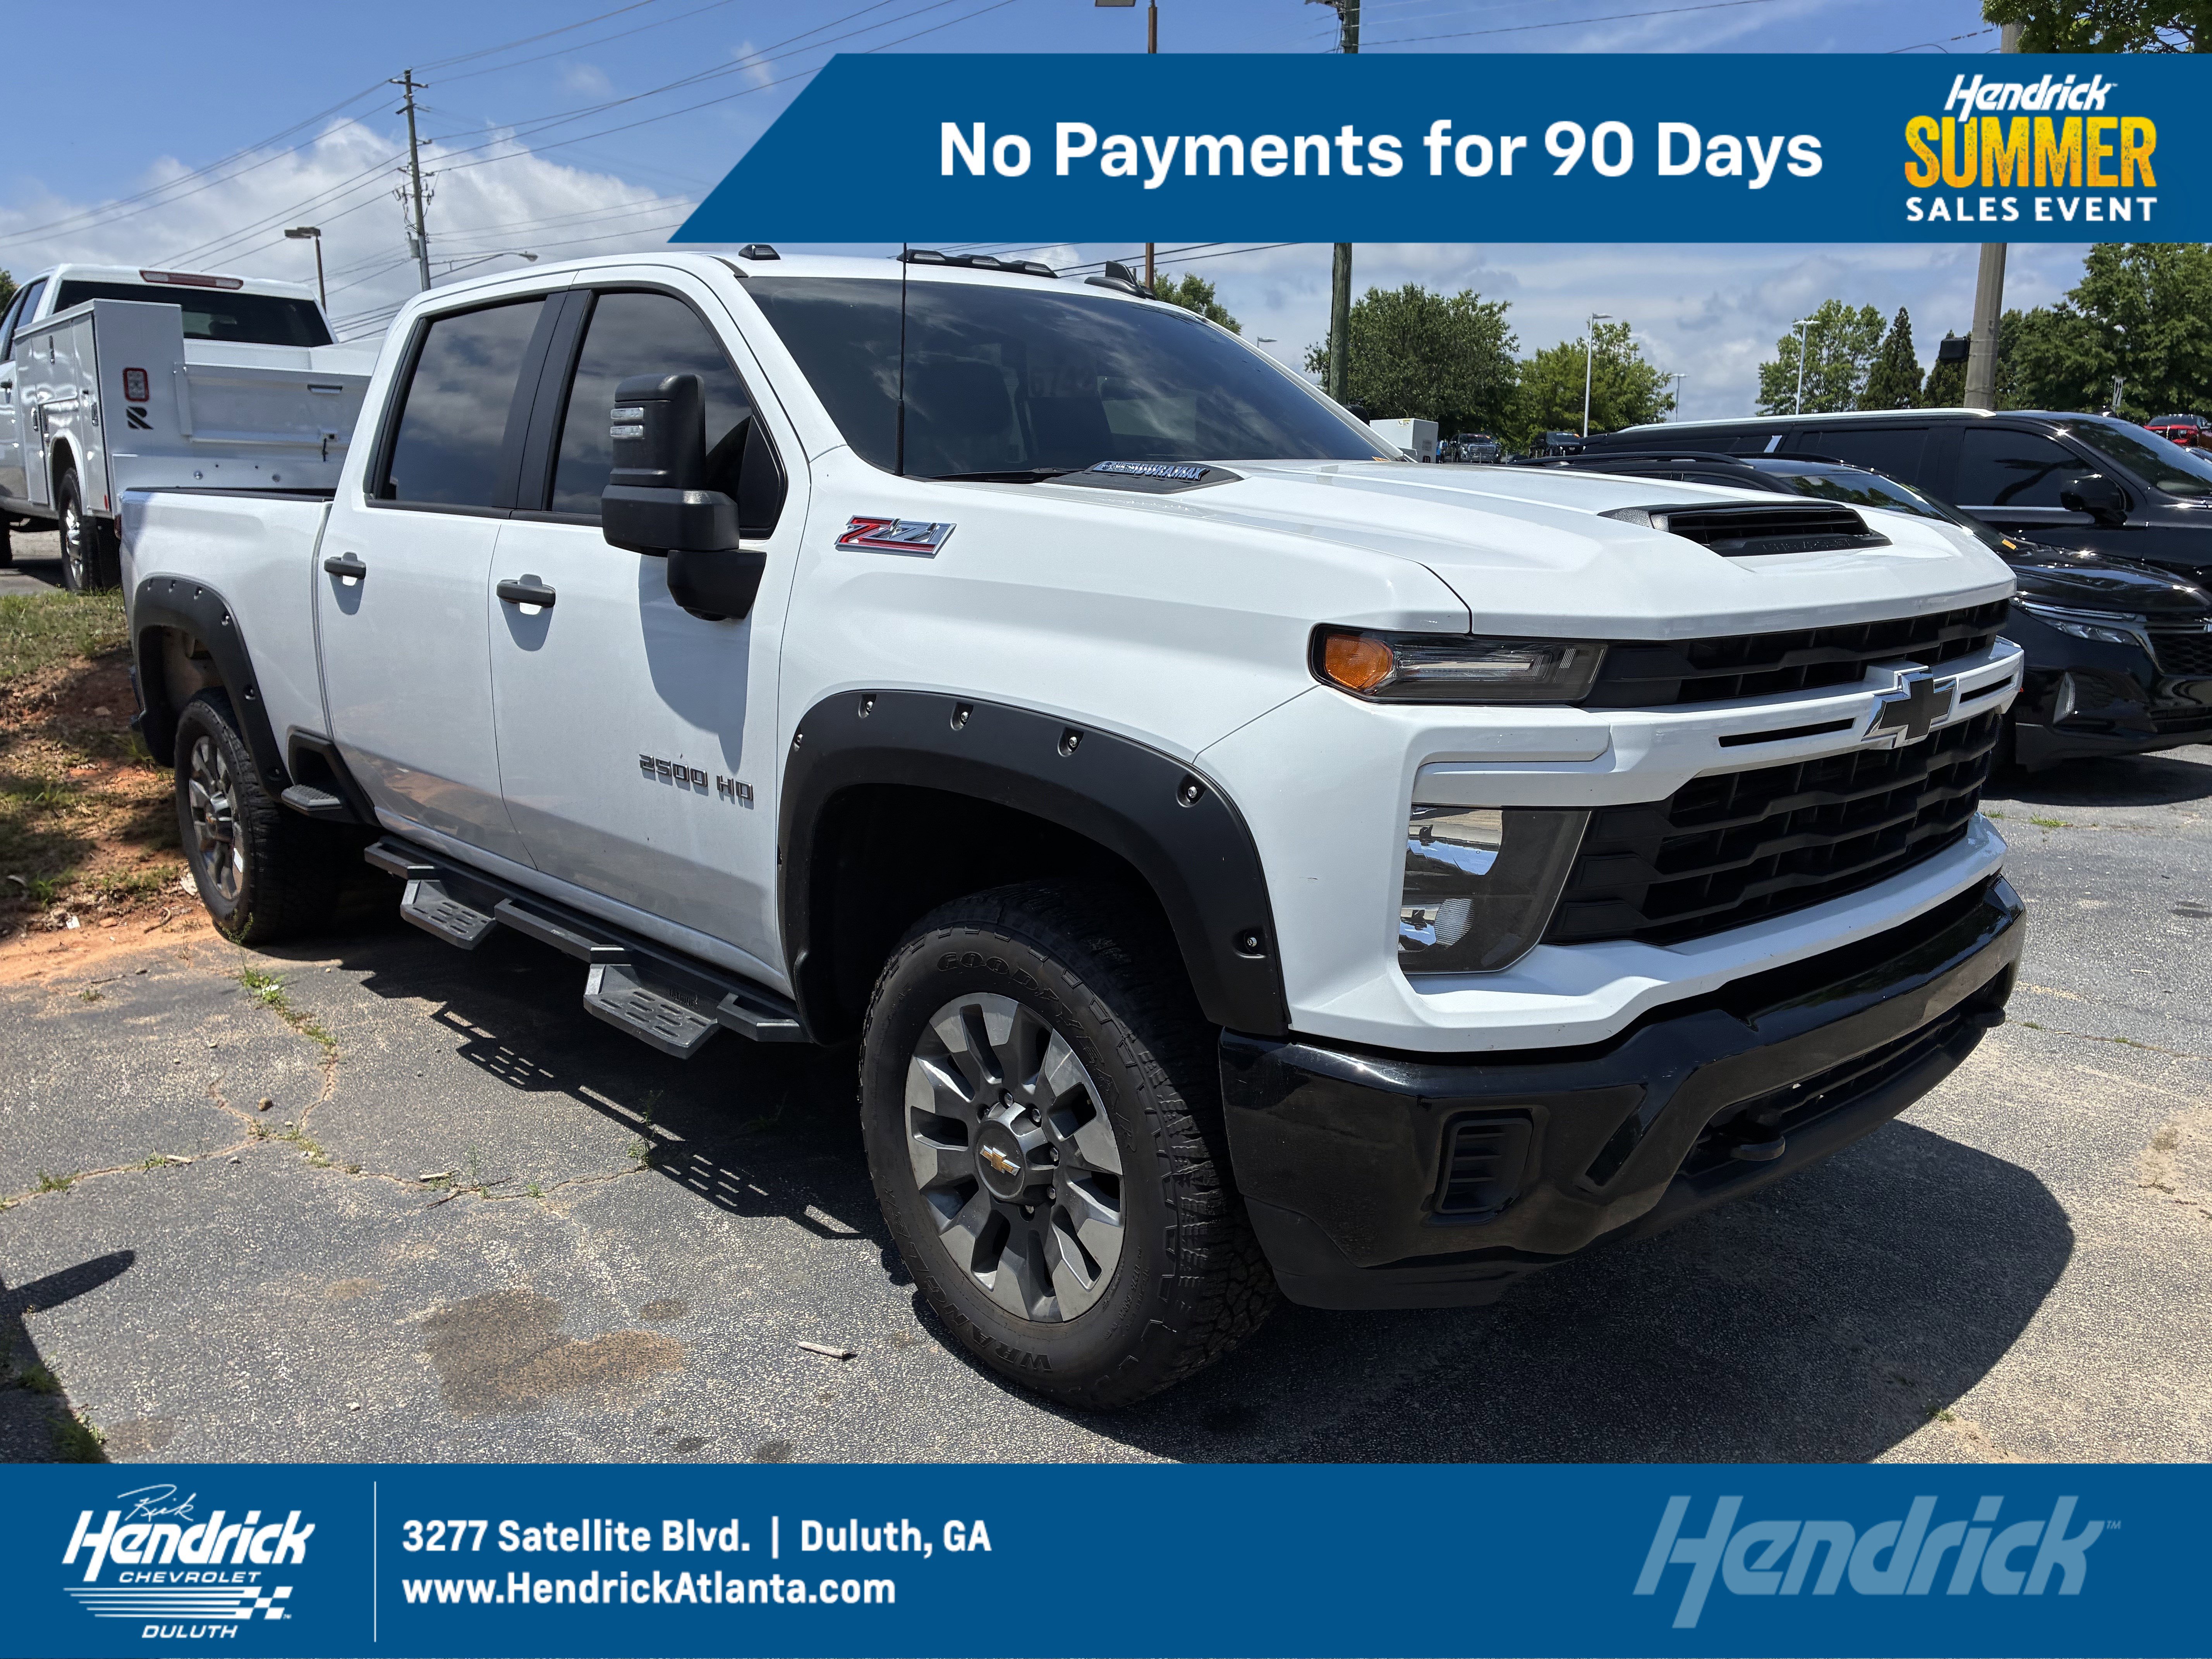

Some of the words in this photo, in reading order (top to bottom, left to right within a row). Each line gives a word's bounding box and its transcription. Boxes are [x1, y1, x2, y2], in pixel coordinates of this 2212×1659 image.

[639, 753, 708, 788] 2500
[716, 775, 753, 800] HD
[937, 951, 1137, 1153] GOODYEAR
